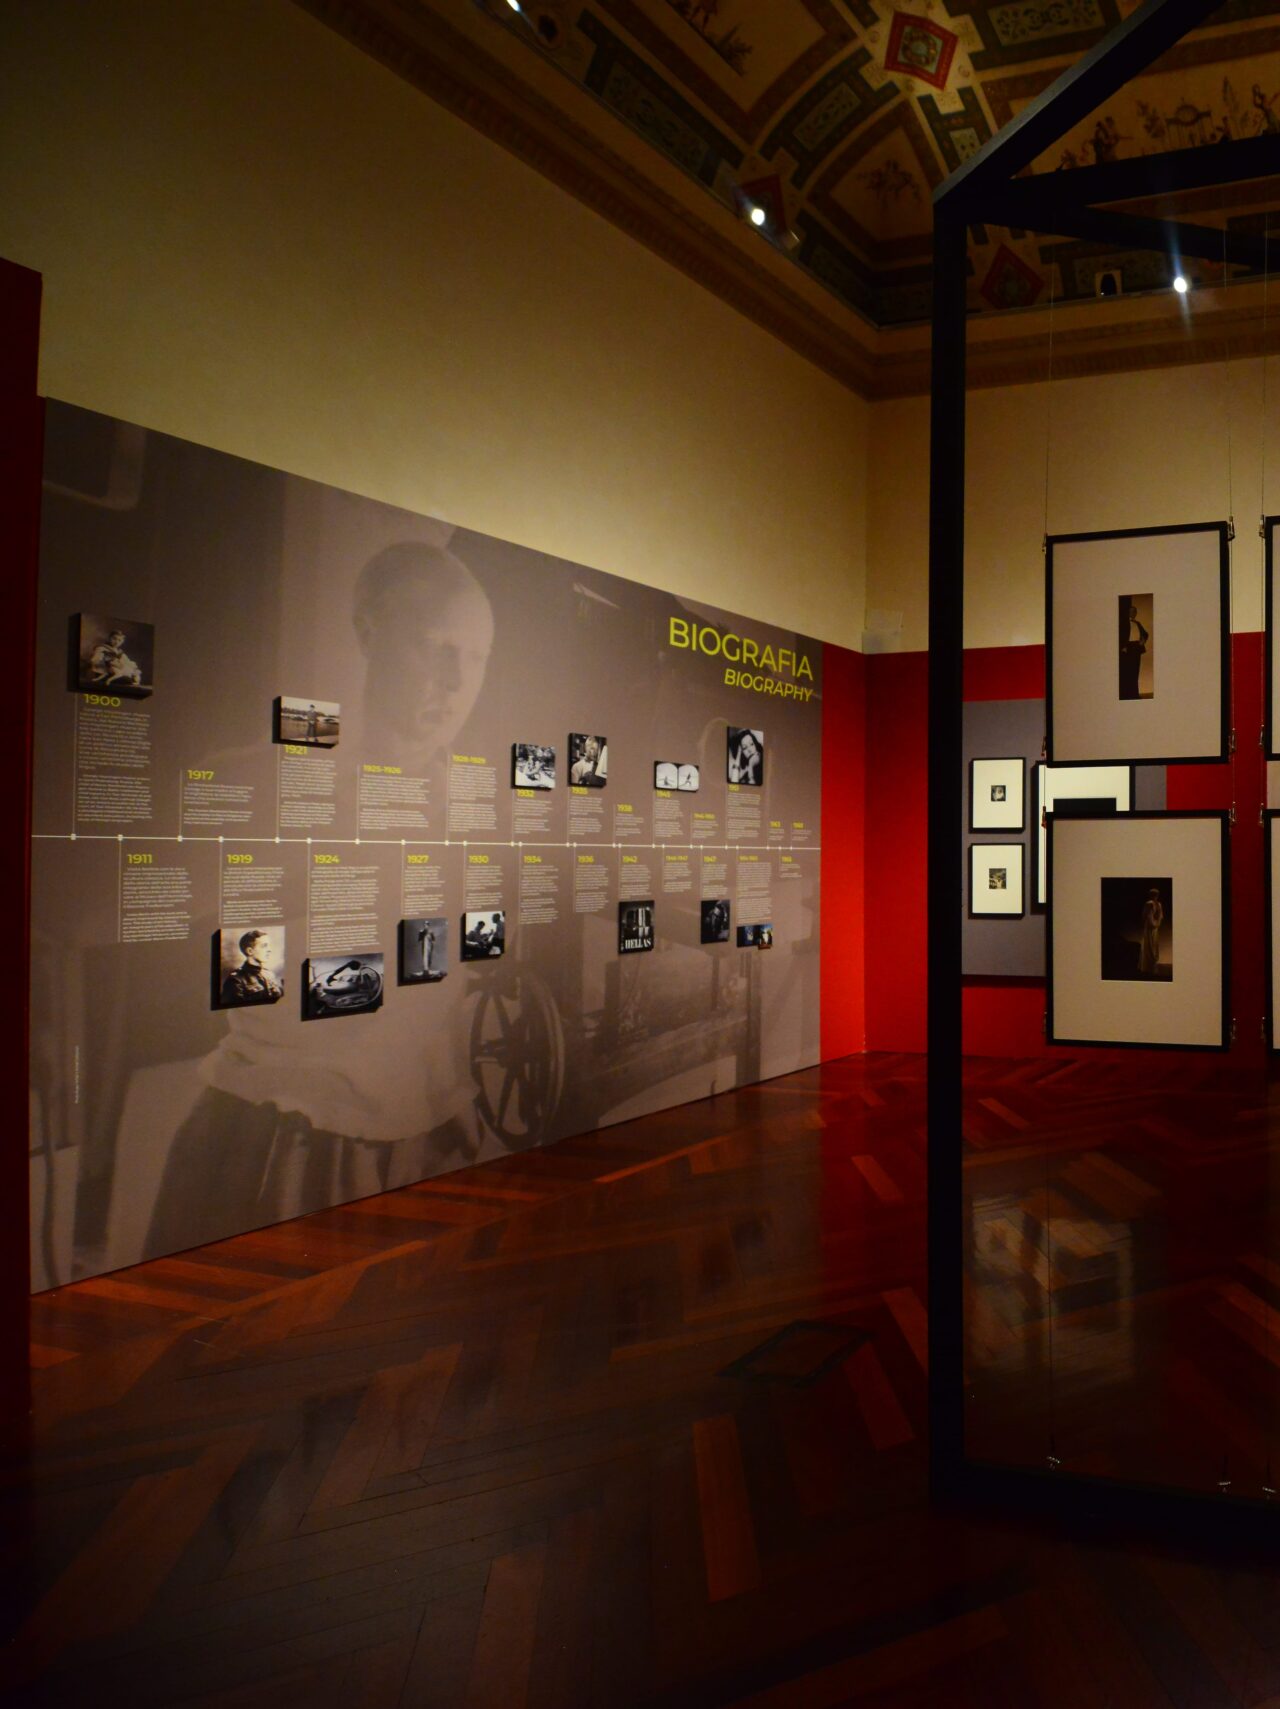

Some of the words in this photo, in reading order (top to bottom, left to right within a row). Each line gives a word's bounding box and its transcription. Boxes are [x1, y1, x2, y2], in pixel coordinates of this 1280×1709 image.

[668, 616, 814, 681] BIOGRAFIA
[723, 668, 815, 702] BIOGRAPHY
[83, 693, 121, 708] 1900
[284, 744, 309, 756] 1921
[187, 769, 215, 781] 1917
[127, 853, 153, 864] 1911
[227, 853, 254, 864] 1919
[313, 853, 341, 865] 1924
[406, 853, 430, 864] 1927
[468, 854, 490, 865] 1930
[523, 854, 544, 864] 1934
[625, 938, 651, 949] HELLAS
